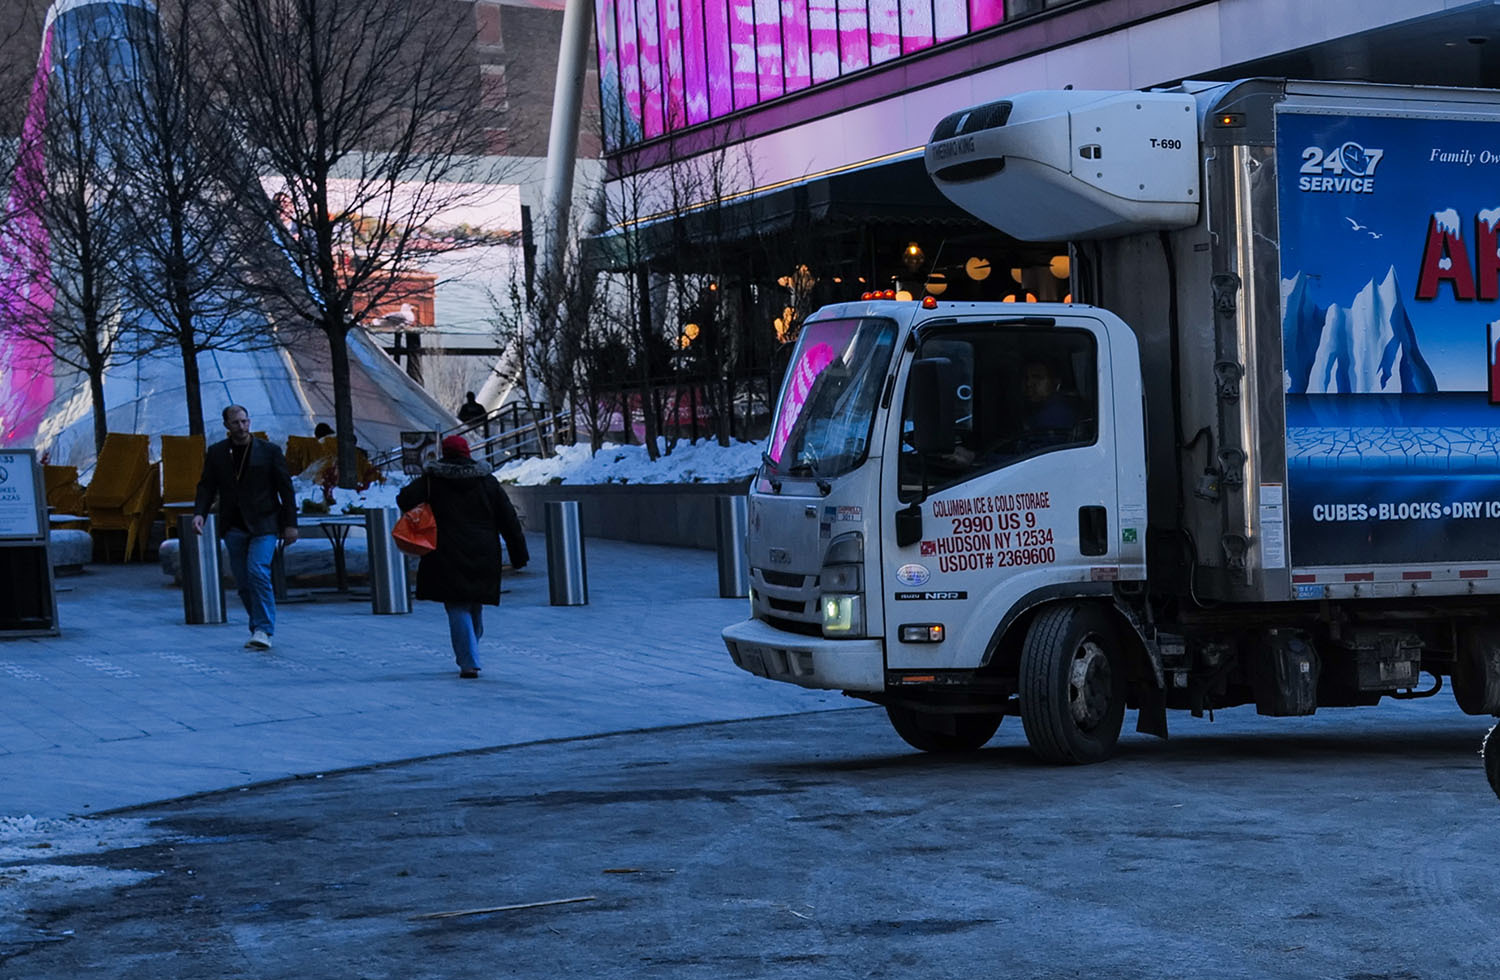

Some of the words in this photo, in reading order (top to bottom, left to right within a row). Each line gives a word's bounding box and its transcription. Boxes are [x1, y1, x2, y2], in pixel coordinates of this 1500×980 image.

[1149, 138, 1182, 151] T-690
[1429, 148, 1476, 166] Family
[1299, 177, 1375, 193] SERVICE
[933, 498, 972, 518] COLUMBIA
[973, 497, 986, 515] ICE
[988, 497, 994, 513] &
[995, 495, 1015, 513] COLD
[1016, 491, 1050, 511] STORAGE
[1312, 503, 1368, 522] CUBES
[1379, 502, 1441, 521] BLOCKS
[1452, 501, 1483, 519] DRY
[952, 516, 993, 535] 2990
[999, 513, 1021, 530] US
[1025, 512, 1036, 528] 9
[937, 534, 991, 554] HUDSON
[994, 532, 1011, 550] NY
[1017, 528, 1054, 547] 12534
[939, 552, 994, 574] USDOT#
[998, 547, 1056, 568] 2369600
